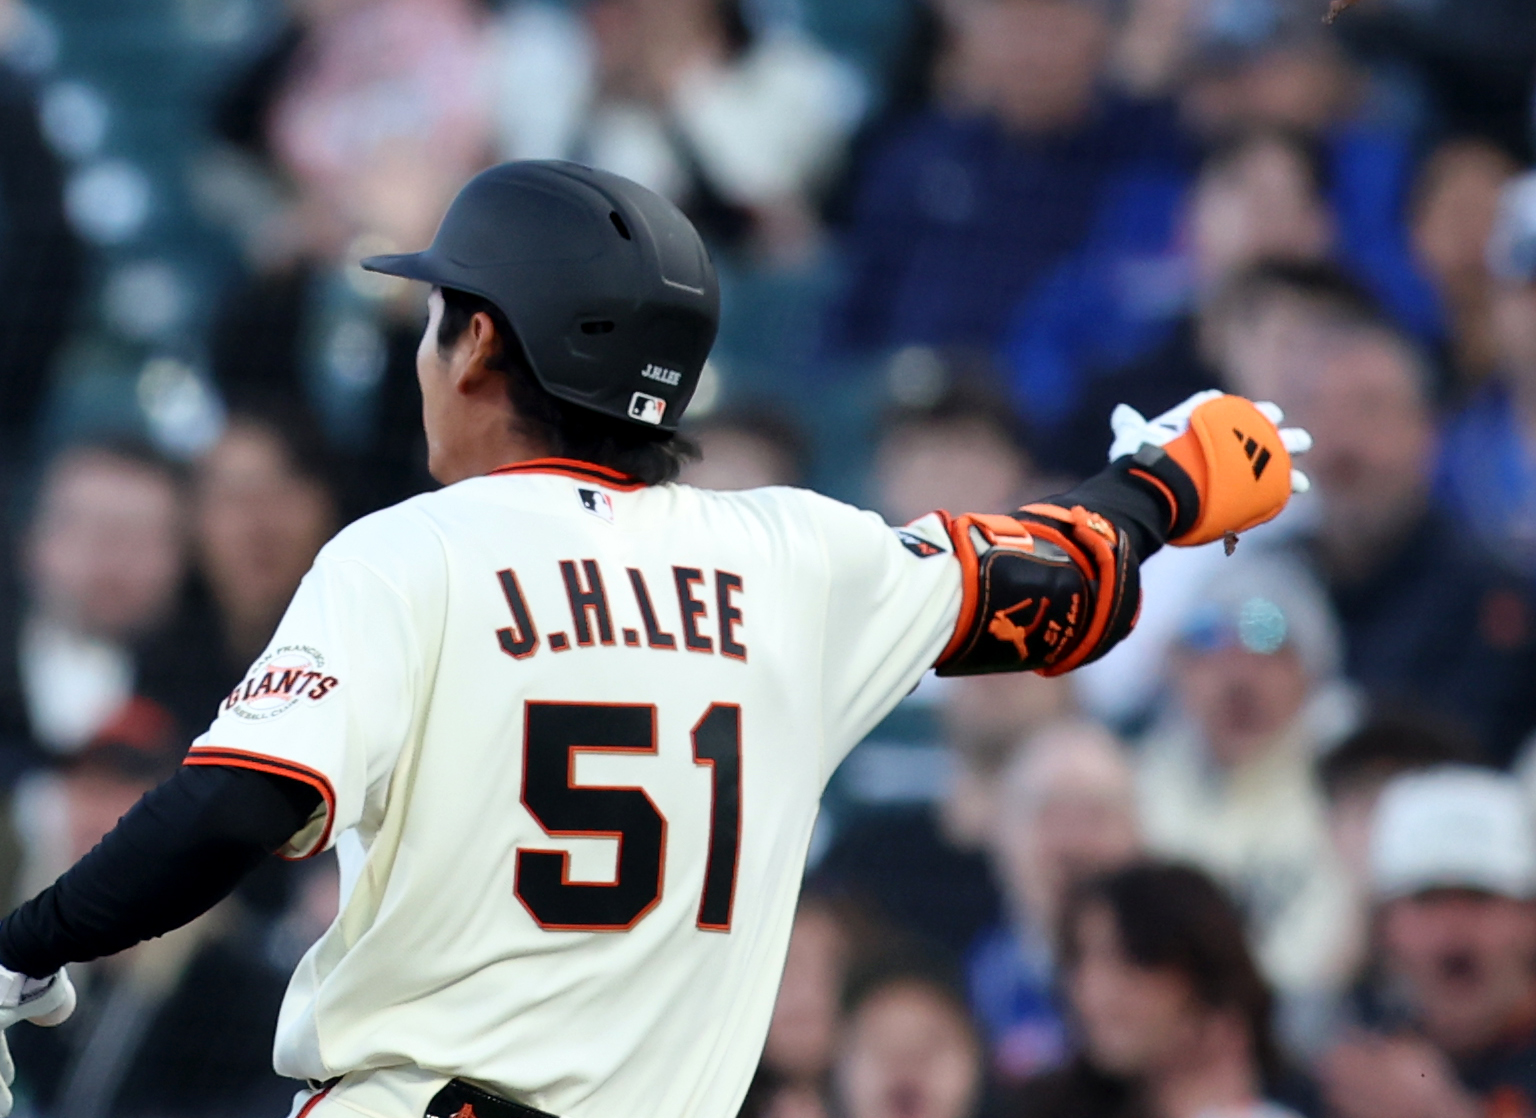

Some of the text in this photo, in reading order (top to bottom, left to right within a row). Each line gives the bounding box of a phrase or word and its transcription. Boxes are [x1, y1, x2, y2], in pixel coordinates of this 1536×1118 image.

[495, 558, 748, 663] J.H.LEE
[224, 669, 339, 711] GIANTS
[513, 699, 743, 933] 51
